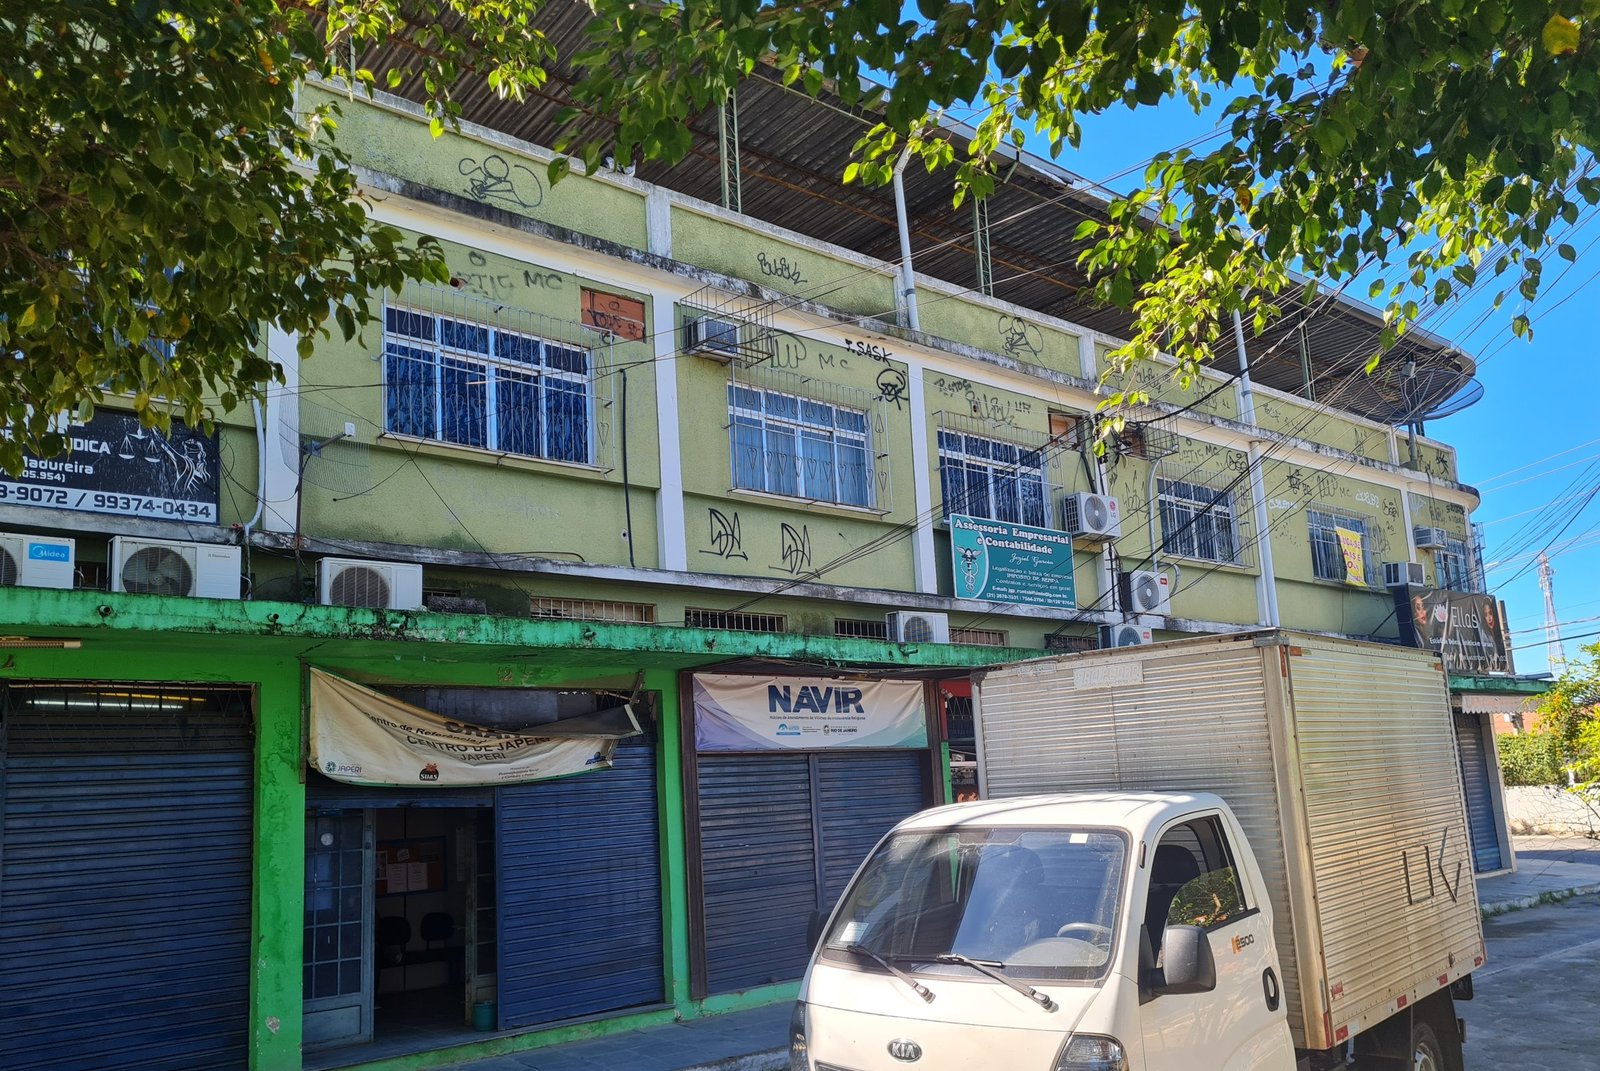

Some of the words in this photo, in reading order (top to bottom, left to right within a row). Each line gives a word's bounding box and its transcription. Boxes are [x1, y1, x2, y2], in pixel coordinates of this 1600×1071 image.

[94, 494, 211, 518] 99374-0434
[955, 519, 1008, 535] Assessoria
[1012, 527, 1069, 545] Empresarial
[985, 536, 1053, 555] Contabilidade
[1007, 573, 1031, 581] IMPOSTO
[768, 685, 864, 713] NAVIR
[406, 735, 468, 752] CENTRO
[460, 752, 506, 761] JAPERI
[337, 765, 362, 774] JAPERI
[891, 1042, 916, 1059] KIA
